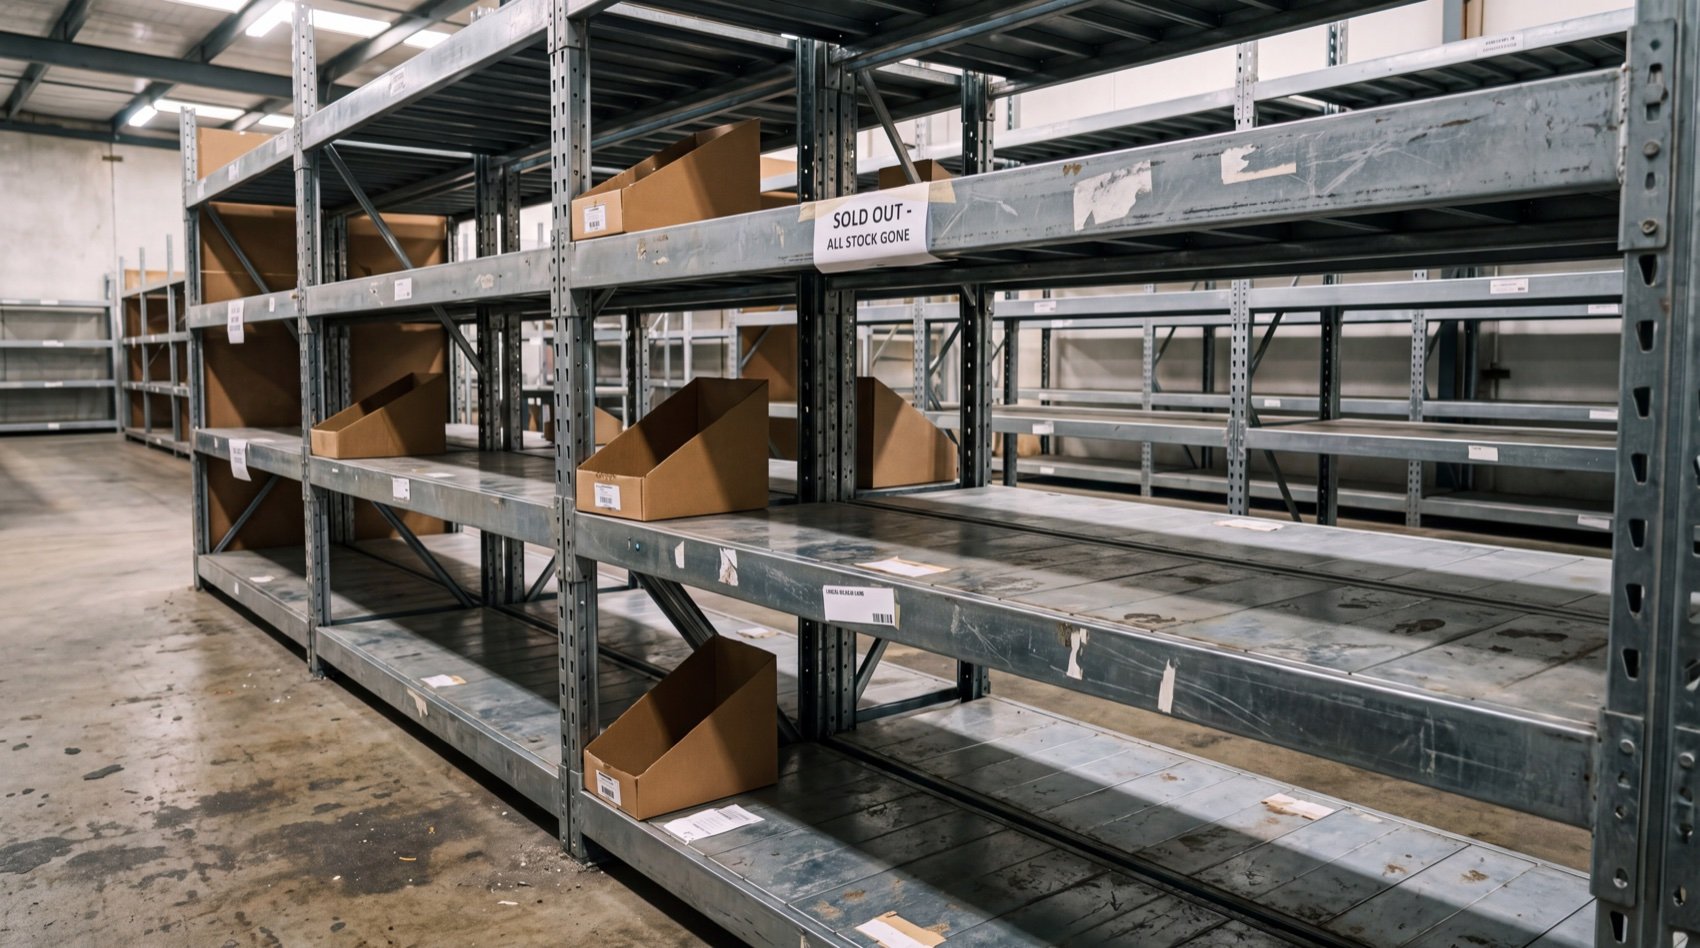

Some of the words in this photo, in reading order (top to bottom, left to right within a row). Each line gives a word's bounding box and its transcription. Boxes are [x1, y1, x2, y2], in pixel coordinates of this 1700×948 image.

[833, 209, 868, 229] SOLD
[873, 203, 903, 223] OUT
[827, 237, 843, 250] ALL
[845, 233, 877, 249] STOCK
[881, 228, 910, 243] GONE
